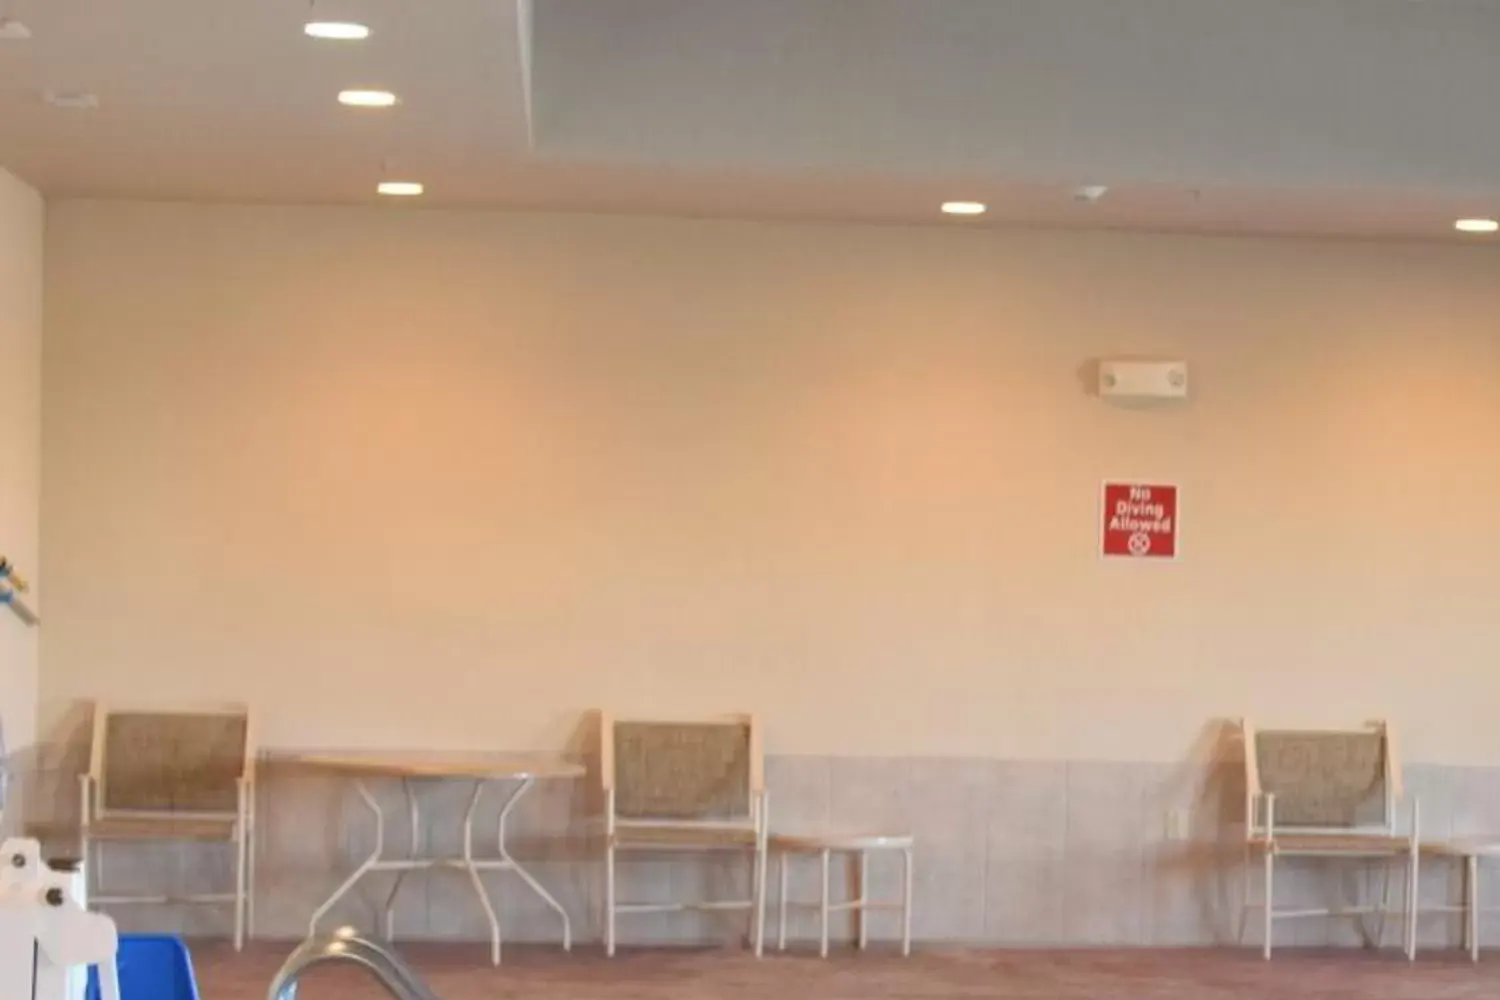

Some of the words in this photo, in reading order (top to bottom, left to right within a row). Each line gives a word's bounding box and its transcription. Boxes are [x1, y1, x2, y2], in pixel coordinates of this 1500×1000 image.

[1130, 486, 1151, 501] No
[1116, 500, 1164, 519] Diving
[1109, 515, 1171, 533] Allowed
